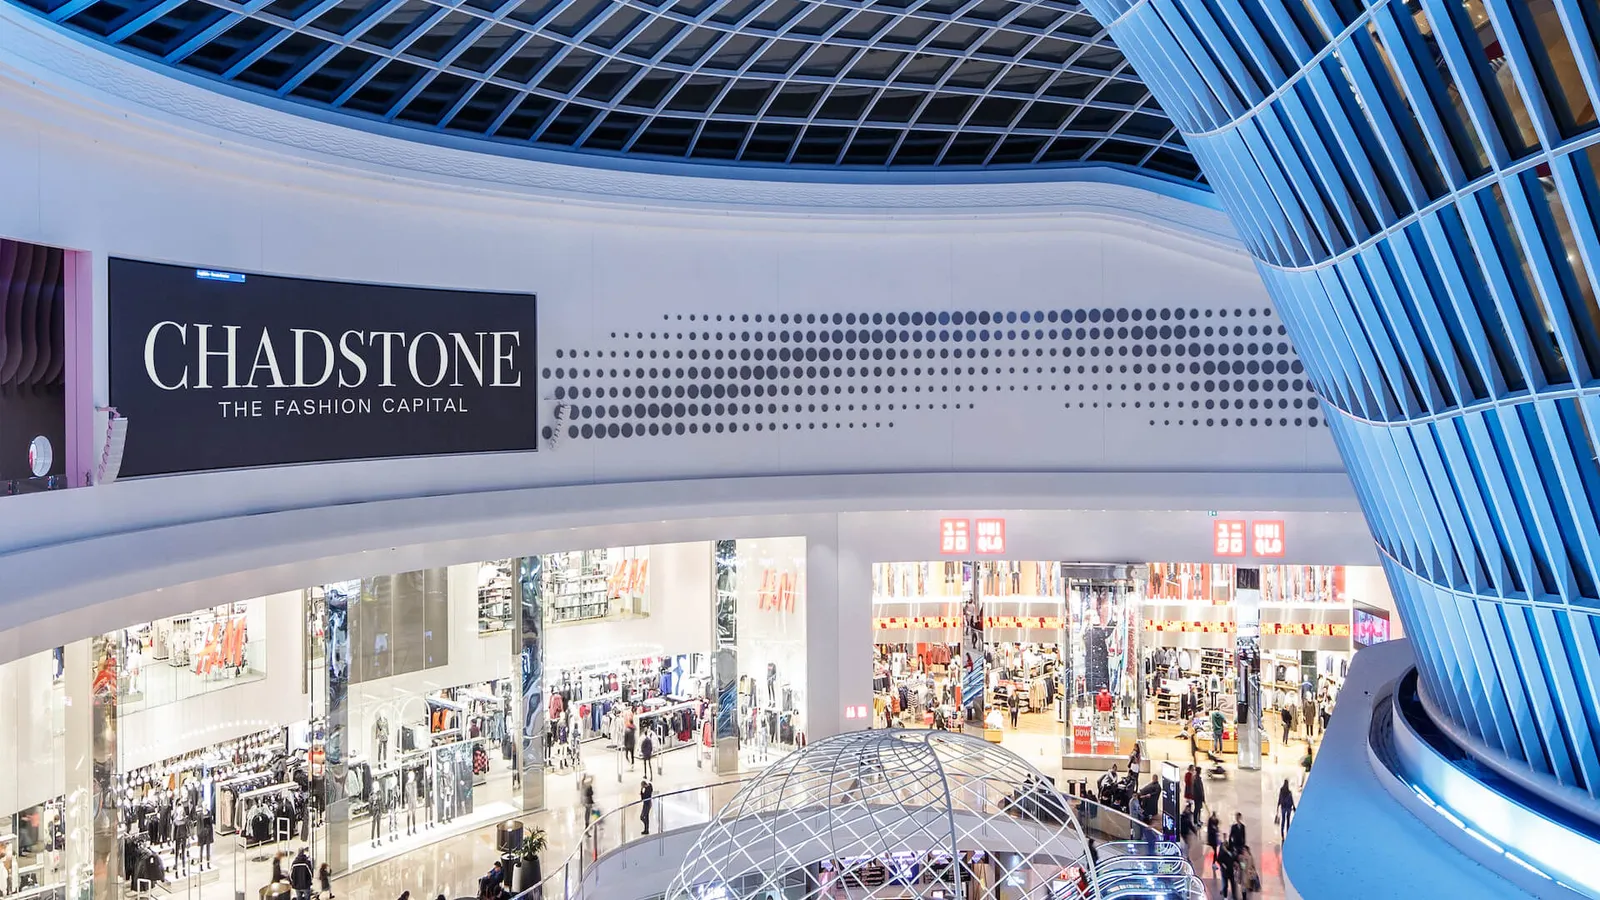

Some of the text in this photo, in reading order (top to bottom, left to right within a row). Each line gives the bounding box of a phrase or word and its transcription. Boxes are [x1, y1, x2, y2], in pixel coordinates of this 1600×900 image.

[144, 320, 521, 391] CHADSTONE
[218, 397, 468, 417] THE FASHION CAPITAL
[607, 557, 649, 598] H&M
[757, 567, 798, 614] H&M
[196, 617, 246, 676] H&M
